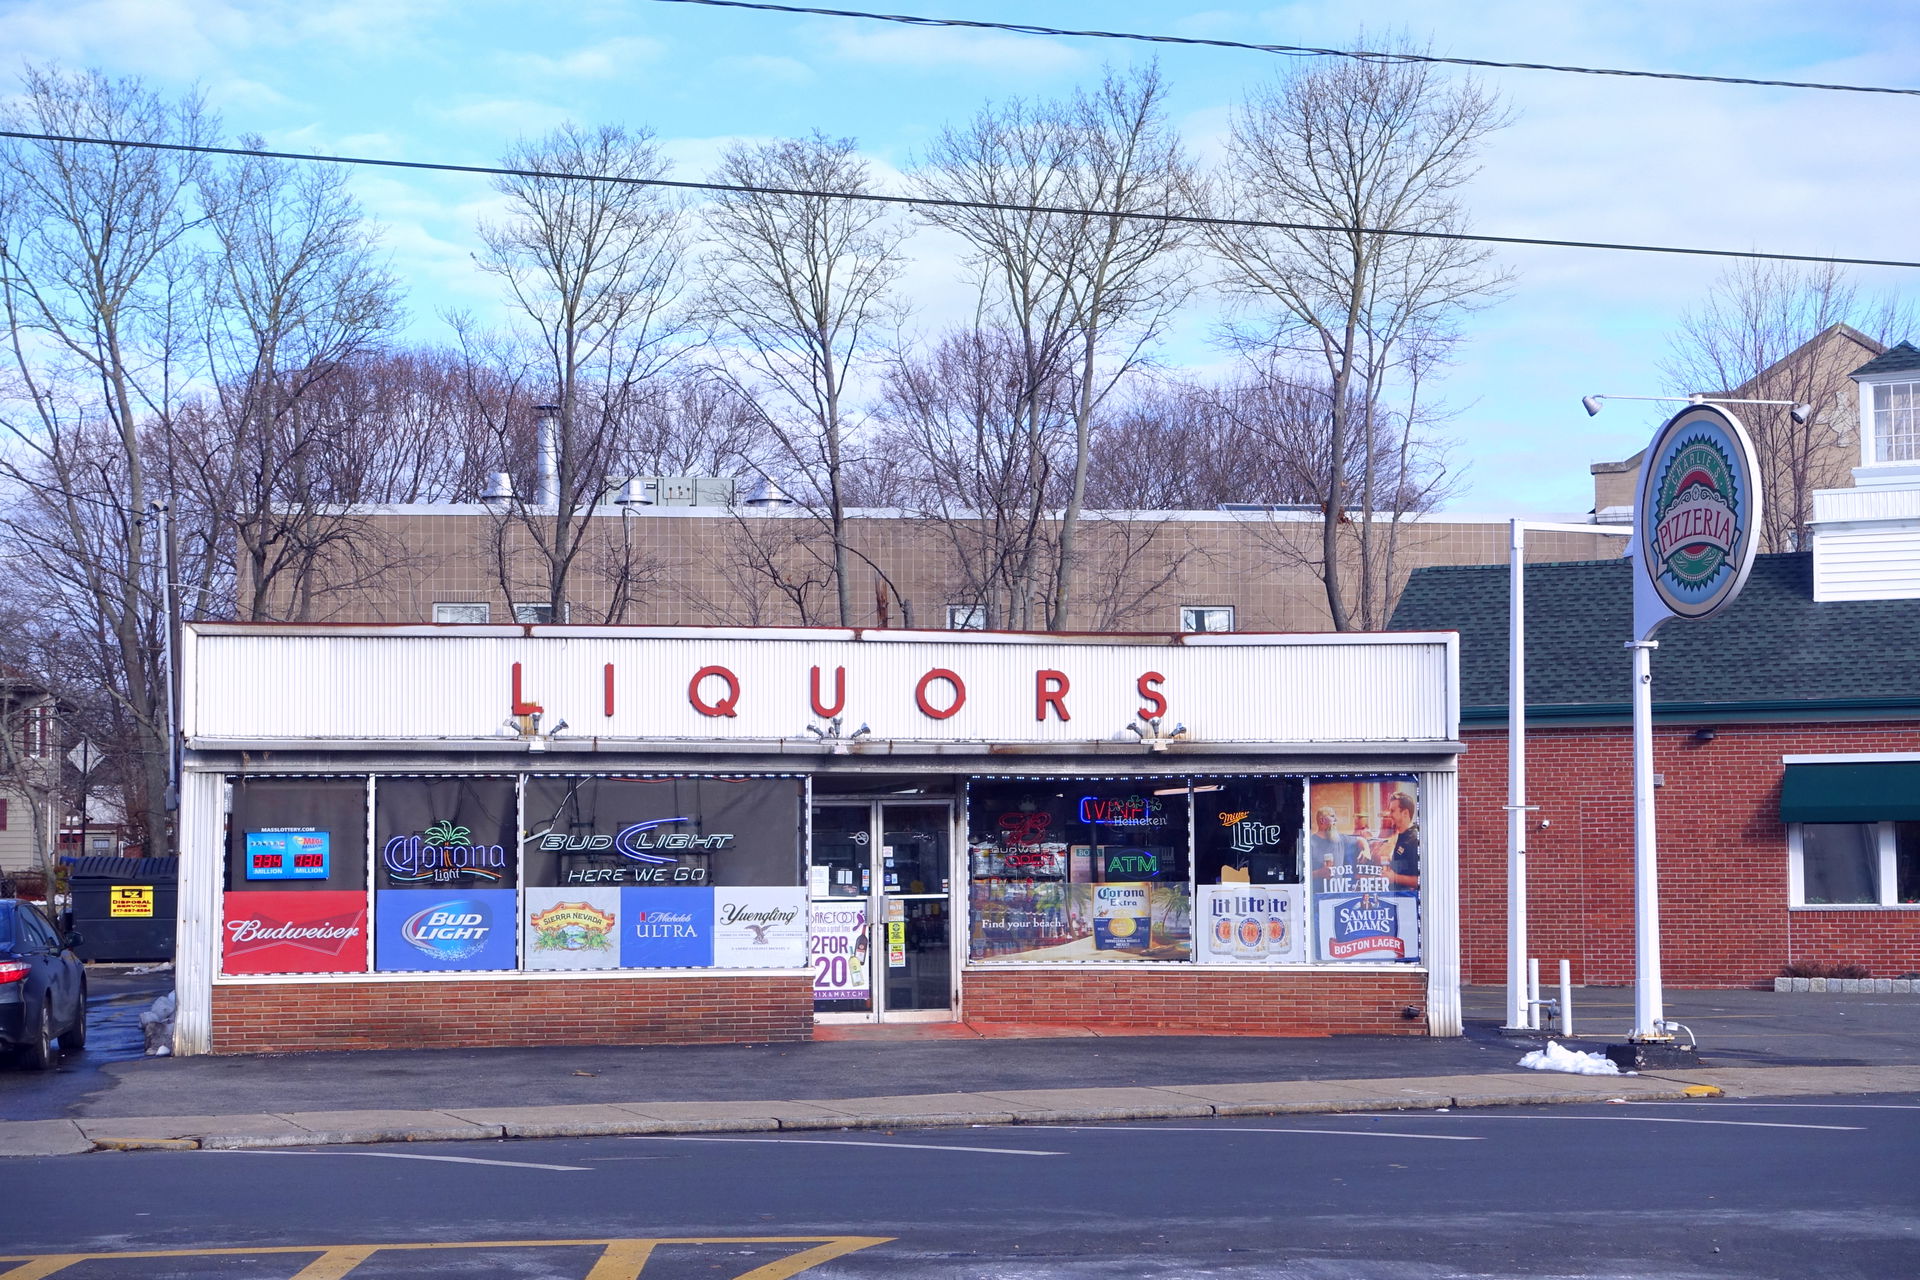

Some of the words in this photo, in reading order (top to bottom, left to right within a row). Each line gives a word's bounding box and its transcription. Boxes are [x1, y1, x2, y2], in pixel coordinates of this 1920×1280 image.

[1671, 452, 1721, 485] CHARLIE'S
[1659, 508, 1732, 553] PIZZERIA
[511, 661, 1168, 722] LIQUORS
[1113, 815, 1167, 827] Heineken
[1218, 811, 1250, 826] Miller
[540, 834, 612, 850] BUD
[636, 833, 734, 849] LIGHT
[1231, 822, 1280, 852] Lite
[384, 836, 506, 876] Corona
[1108, 856, 1157, 872] ATM
[1329, 864, 1353, 877] FOR
[1357, 864, 1382, 876] THE
[434, 868, 460, 882] Light
[568, 869, 626, 882] HERE
[635, 868, 667, 881] WE
[674, 867, 705, 881] GO
[1323, 878, 1352, 893] LOVE
[1361, 877, 1390, 892] BEER
[1098, 887, 1145, 902] Corona
[1110, 898, 1138, 906] Extra
[1212, 898, 1230, 917] Lit
[1235, 896, 1265, 917] Lite
[1268, 898, 1288, 913] ite
[428, 912, 482, 926] BUD
[543, 913, 571, 925] SIERRA
[572, 912, 603, 925] NEVADA
[647, 912, 692, 924] Michelob
[720, 903, 799, 926] Yuengling
[1340, 907, 1394, 923] SAMUEL
[226, 919, 360, 943] Budweiser
[636, 924, 698, 938] ULTRA
[982, 918, 1005, 929] Find
[1007, 920, 1031, 931] your
[1033, 917, 1065, 929] beach.
[1344, 920, 1390, 935] ADAMS
[415, 926, 490, 940] LIGHT
[1334, 940, 1370, 955] BOSTON
[1371, 938, 1401, 949] LAGER
